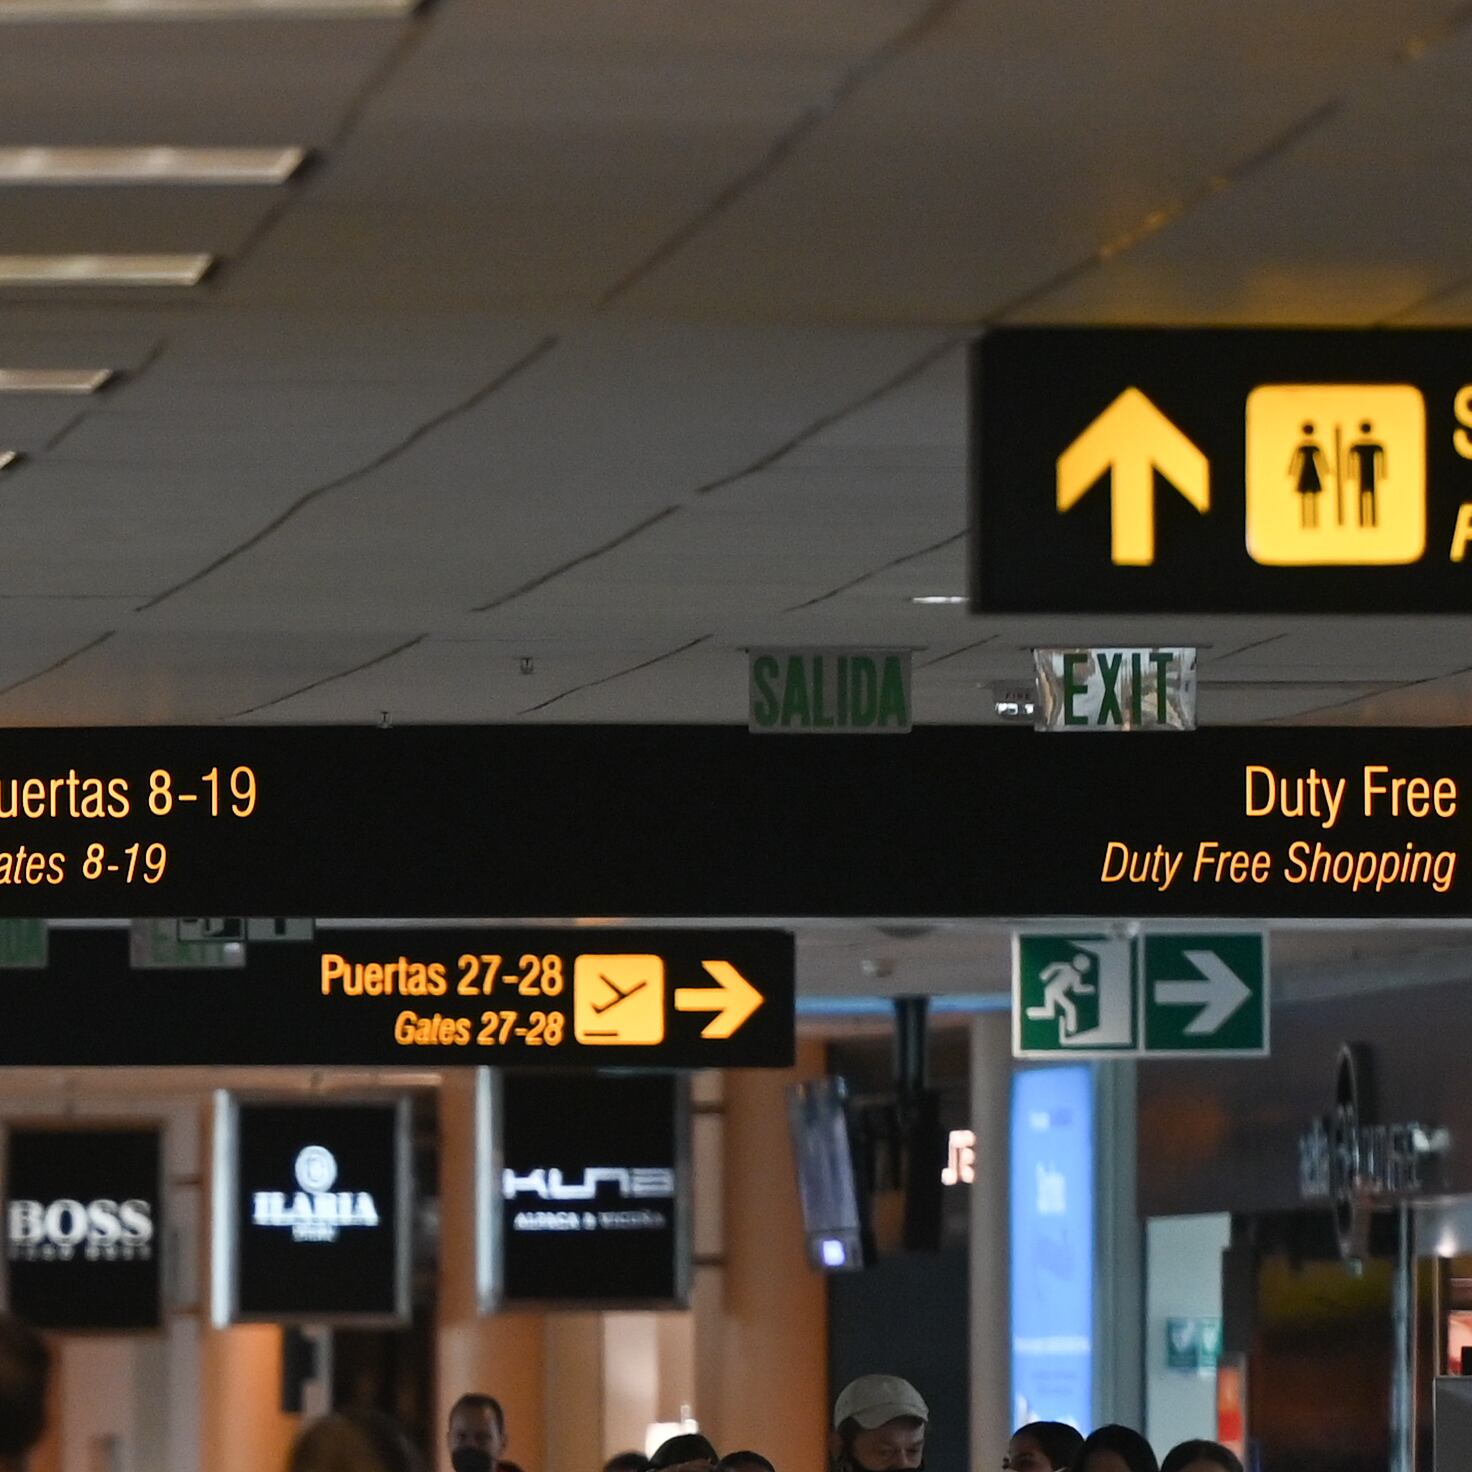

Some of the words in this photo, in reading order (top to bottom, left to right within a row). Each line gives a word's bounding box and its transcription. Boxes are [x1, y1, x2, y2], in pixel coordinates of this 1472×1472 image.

[752, 654, 908, 727] SALIDA
[1063, 652, 1174, 726] EXIT
[148, 765, 257, 818] 8-19
[1245, 765, 1346, 829] Duty
[1363, 765, 1457, 818] Free
[82, 842, 168, 884] 8-19
[1100, 841, 1183, 892] Duty
[1192, 841, 1271, 883] Free
[1283, 840, 1457, 893] Shopping
[320, 953, 448, 996] Puertas
[456, 953, 564, 996] 27-28
[394, 1010, 472, 1046] Gates
[476, 1010, 565, 1047] 27-28
[7, 1198, 154, 1246] BOSS
